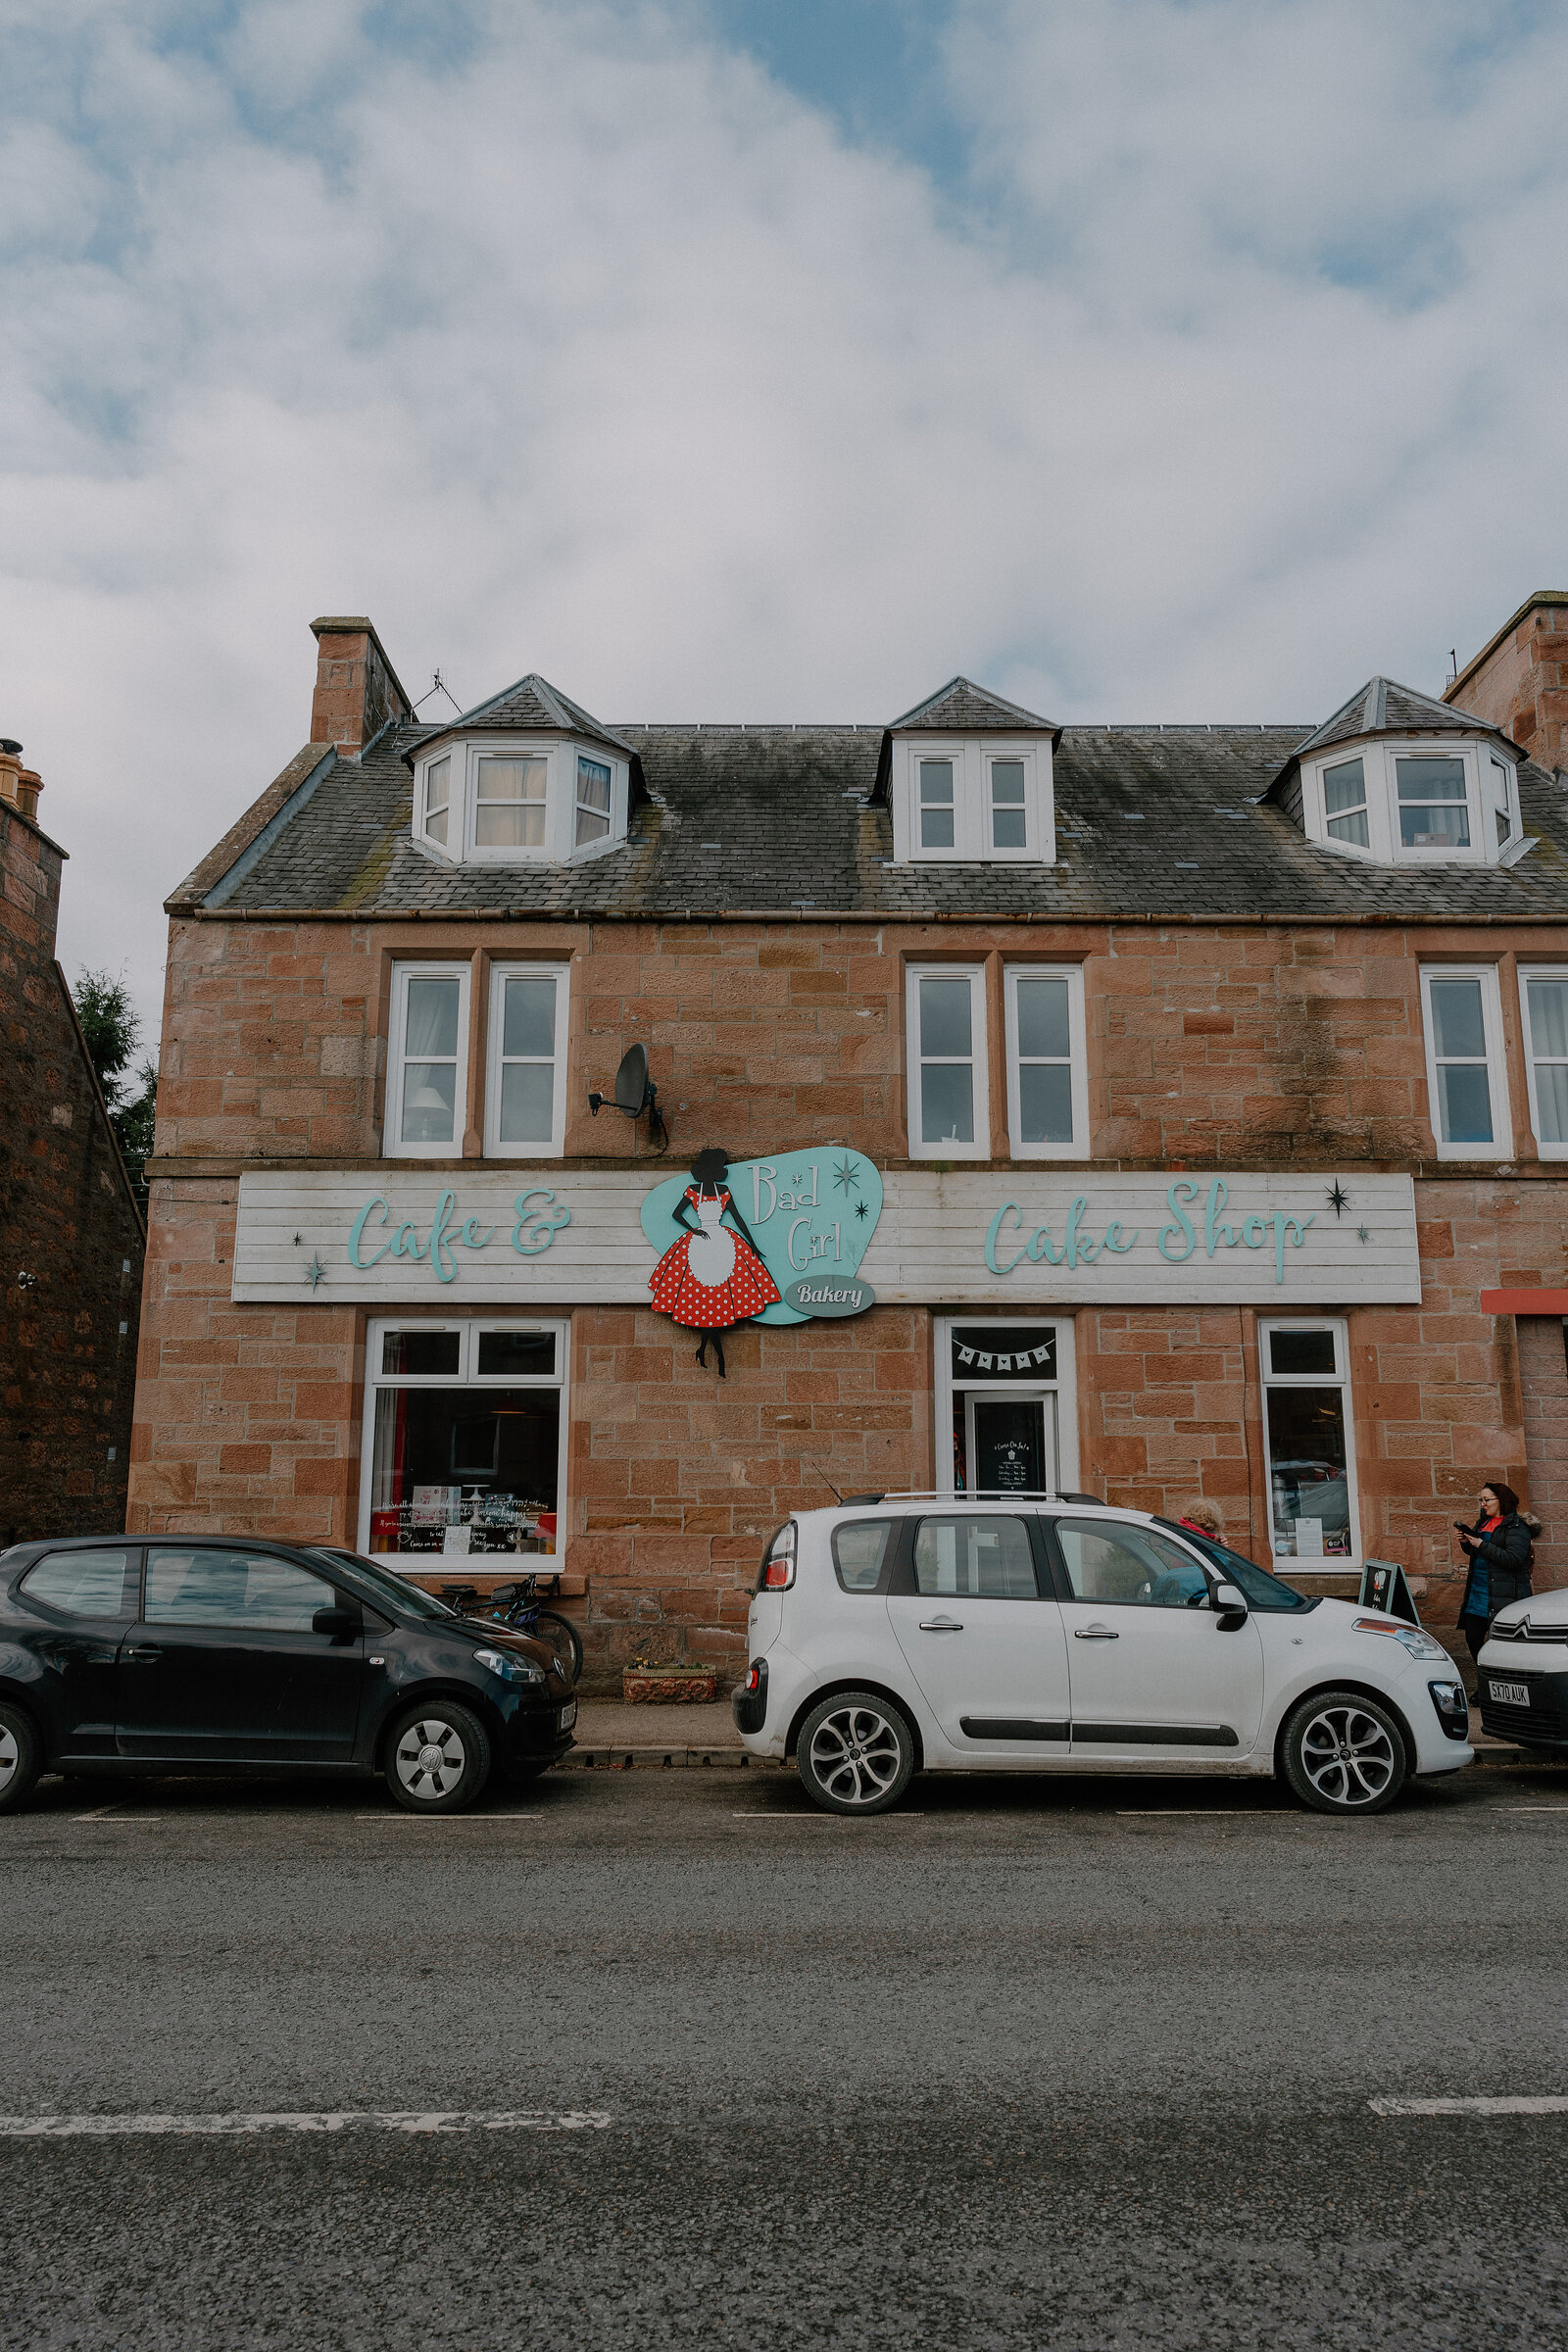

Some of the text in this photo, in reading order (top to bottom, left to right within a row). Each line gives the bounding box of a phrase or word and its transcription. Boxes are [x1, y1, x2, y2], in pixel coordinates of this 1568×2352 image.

[747, 1165, 821, 1225] Bad
[348, 1188, 571, 1283] Cafe &
[787, 1216, 842, 1271] Girl
[984, 1177, 1316, 1285] Cake Shop
[797, 1284, 862, 1308] Bakery
[1492, 1683, 1527, 1703] SX70 AUK
